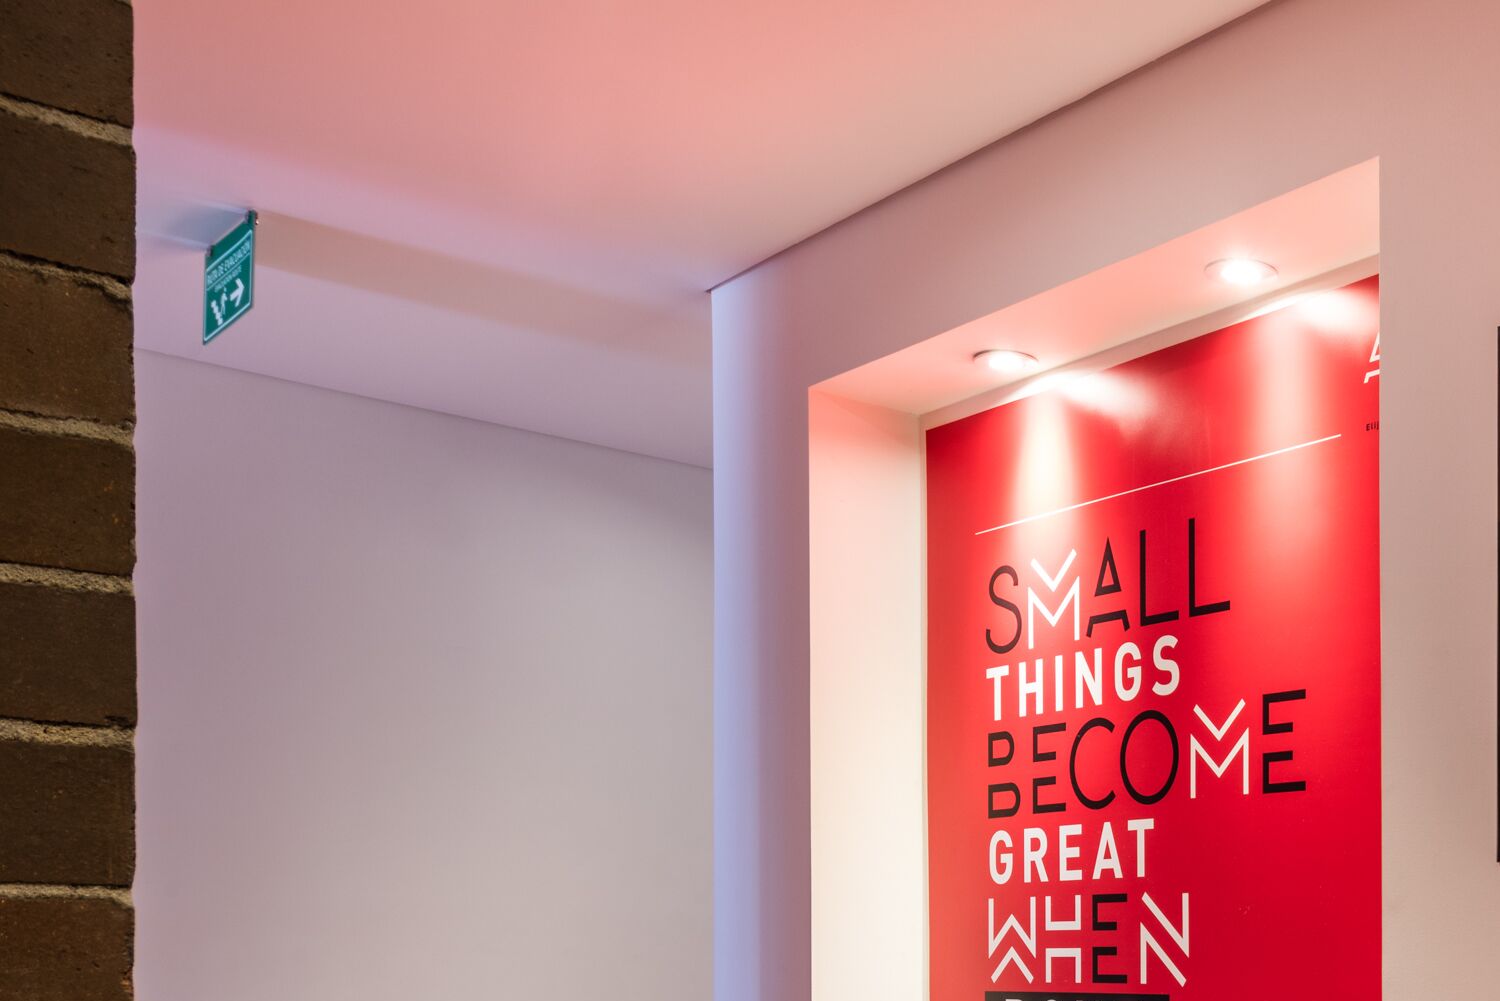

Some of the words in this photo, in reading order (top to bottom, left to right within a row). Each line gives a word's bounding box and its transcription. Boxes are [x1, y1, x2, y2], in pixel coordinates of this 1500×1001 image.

[1365, 421, 1380, 431] Elij
[985, 517, 1231, 654] SMALL
[985, 634, 1180, 721] THINGS
[987, 688, 1306, 819] BECOME
[988, 818, 1155, 885] GREAT
[988, 892, 1190, 988] WHEN
